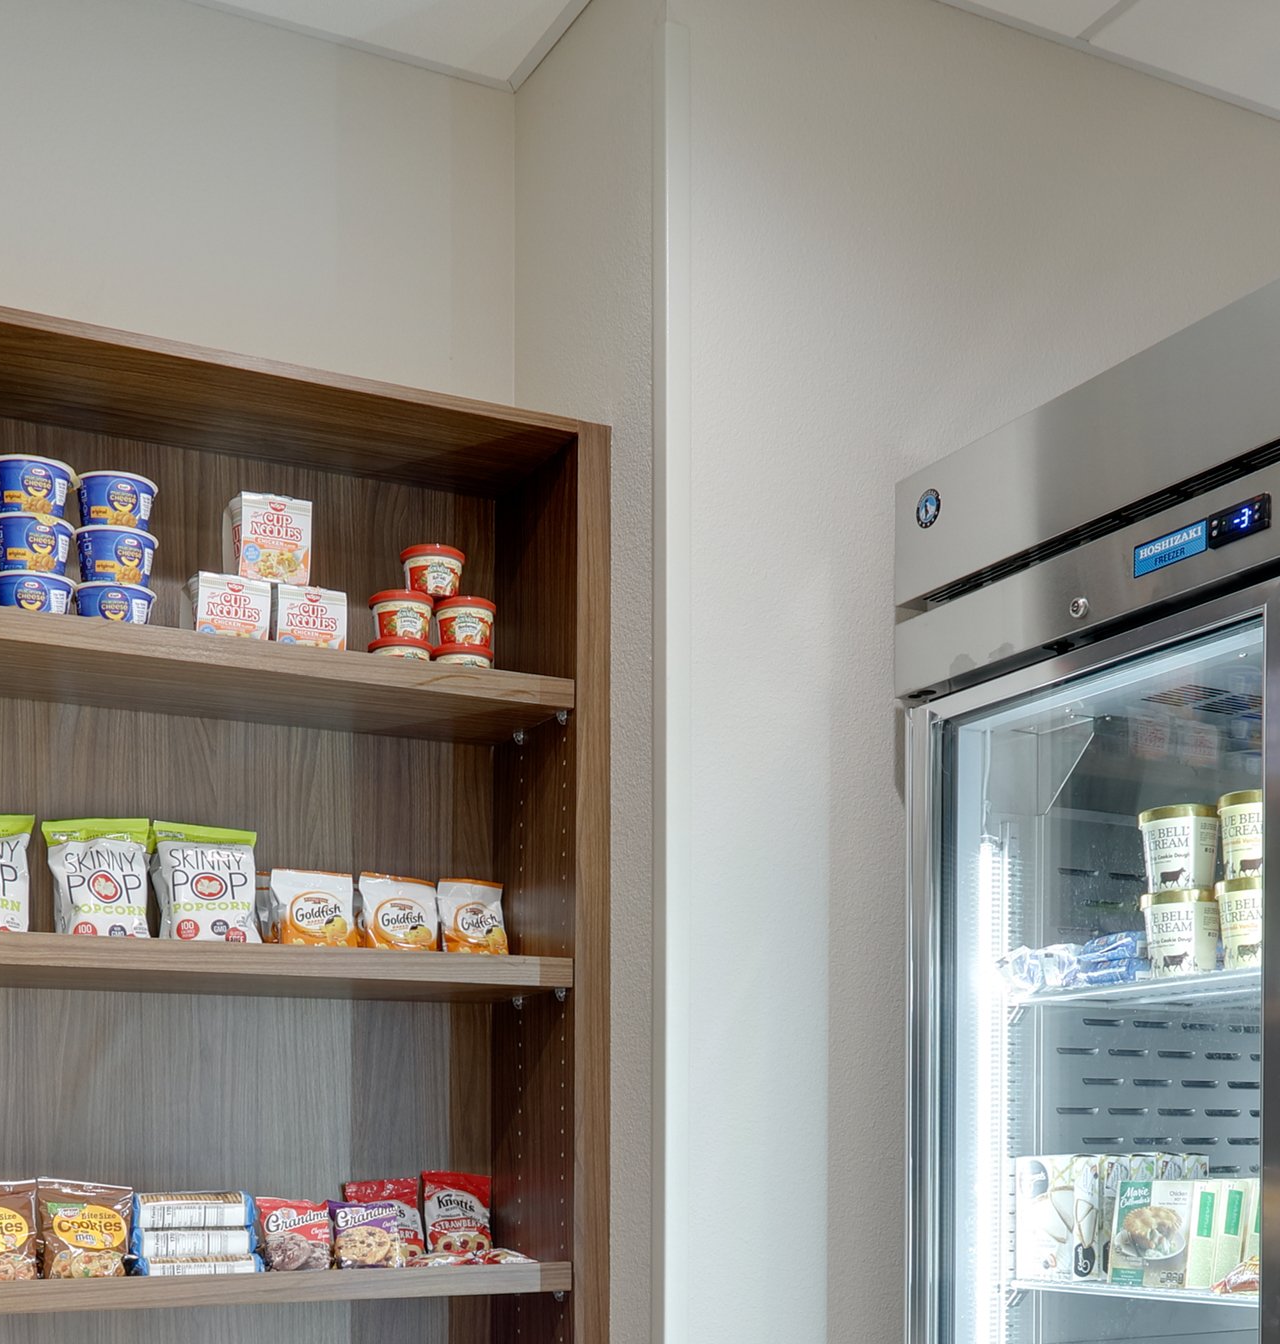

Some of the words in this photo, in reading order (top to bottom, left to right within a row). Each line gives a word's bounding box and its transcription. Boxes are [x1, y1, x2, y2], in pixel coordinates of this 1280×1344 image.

[263, 512, 292, 525] CUP
[251, 521, 302, 541] NOODLES
[257, 537, 284, 546] CHICKEN
[1140, 526, 1202, 559] HOSHIZAKI
[1154, 548, 1185, 566] FREEZER
[221, 594, 250, 607] CUP
[207, 603, 260, 622] NOODLES
[299, 603, 327, 617] CUP
[213, 619, 241, 627] CHICKEN
[287, 613, 337, 631] NOODLES
[293, 629, 319, 638] CHICKEN
[1158, 826, 1187, 838] BELL
[67, 870, 142, 905] POP
[172, 871, 248, 902] POP
[74, 902, 147, 917] POPCORN
[173, 902, 251, 912] POPCORN
[295, 904, 341, 923] Goldfish
[381, 907, 425, 927] Goldfish
[1162, 911, 1190, 922] BELL
[78, 924, 92, 934] 100
[180, 919, 196, 929] 100
[1126, 1186, 1150, 1199] Marie
[437, 1193, 475, 1213] Knott's
[81, 1211, 95, 1220] Bite
[96, 1211, 117, 1220] Size
[57, 1218, 122, 1237] Cookies
